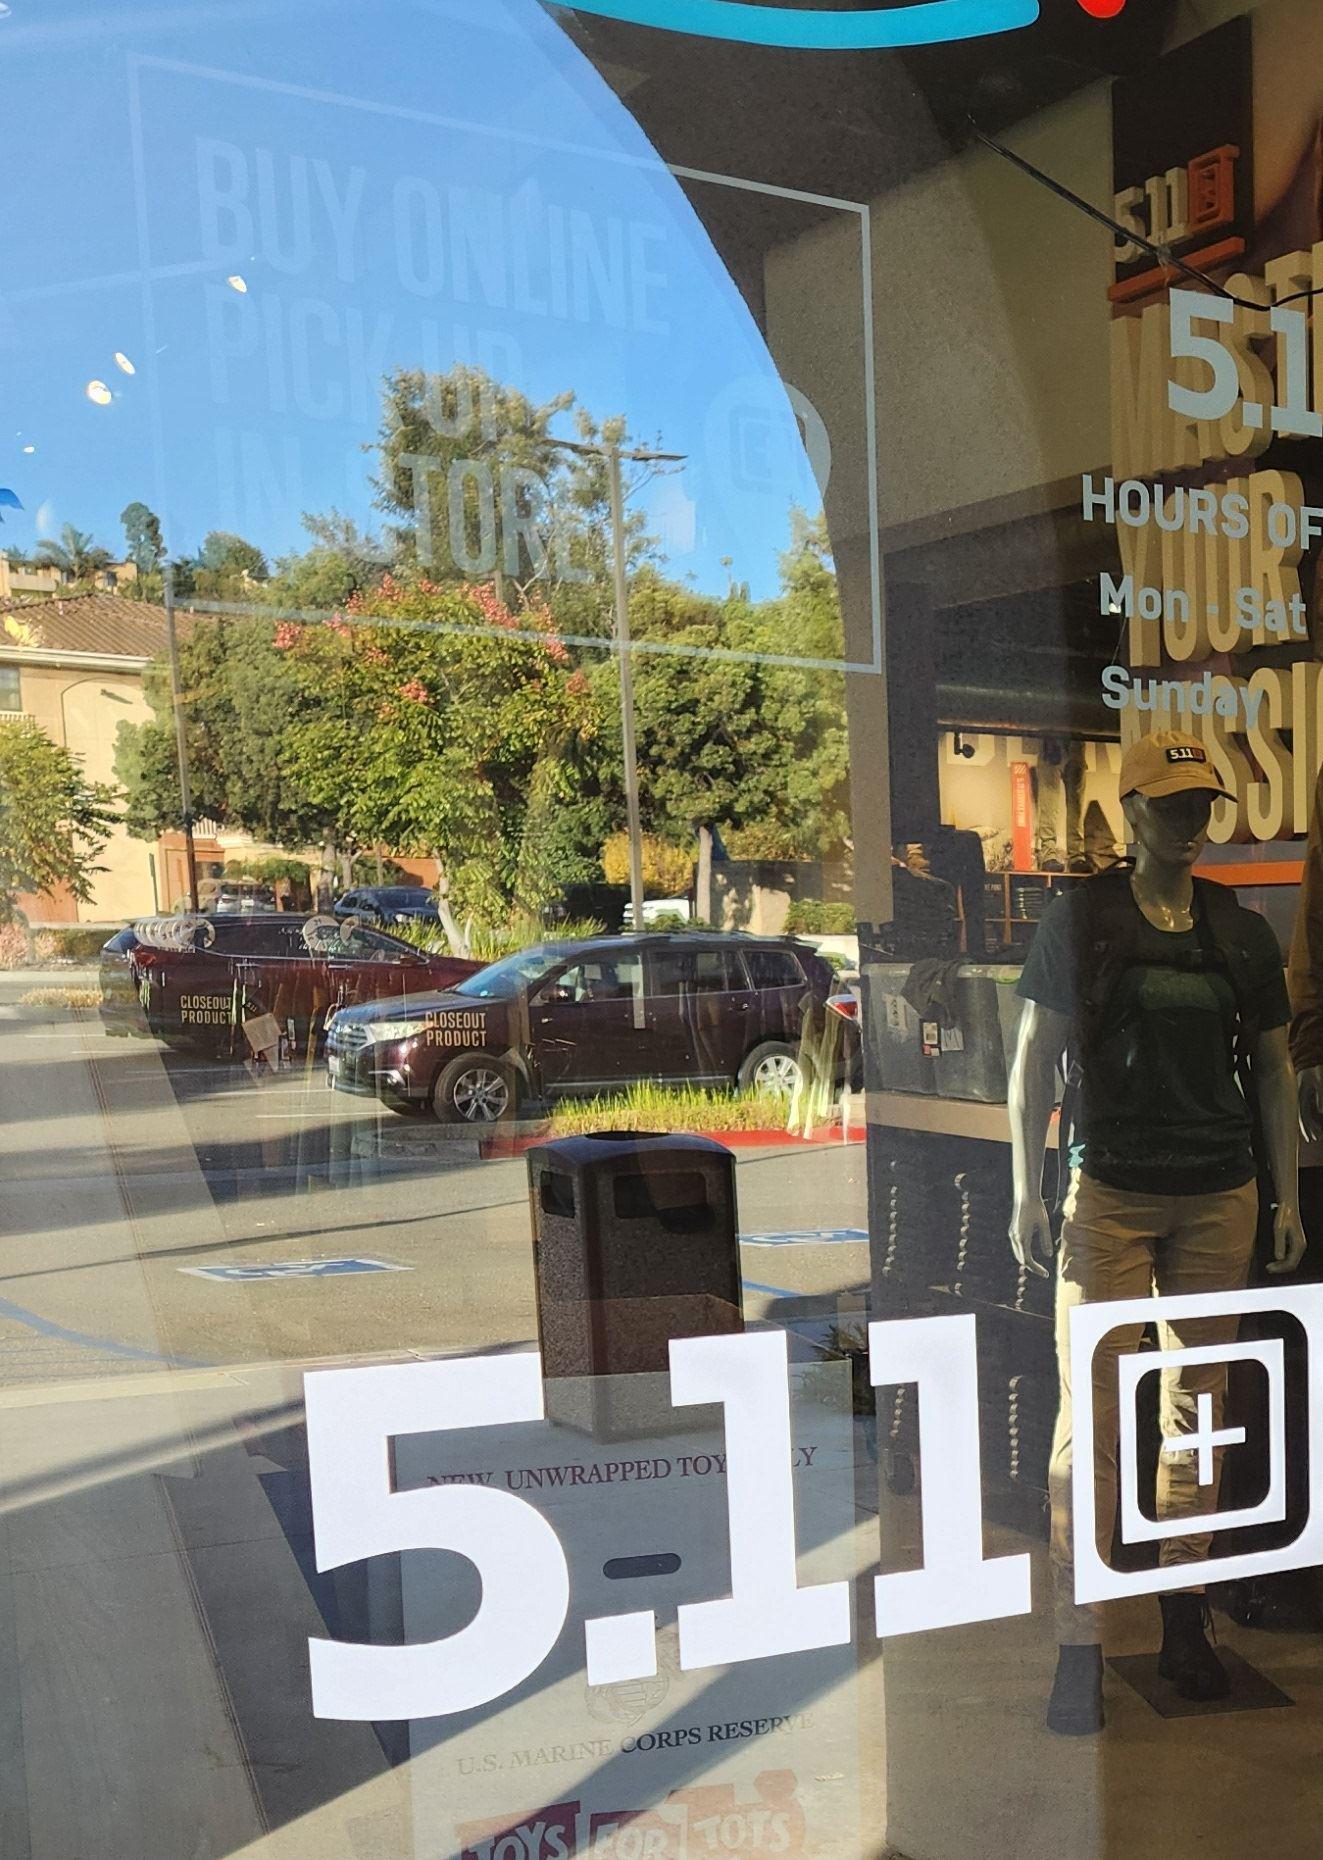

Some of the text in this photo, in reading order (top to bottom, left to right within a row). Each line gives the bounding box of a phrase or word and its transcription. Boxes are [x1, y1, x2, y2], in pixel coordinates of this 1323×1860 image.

[194, 136, 671, 336] BUY ONLINE
[204, 281, 524, 442] PICK UP
[1082, 474, 1249, 540] HOURS
[1118, 469, 1310, 668] YOUR
[1100, 572, 1191, 622] Mon
[1236, 586, 1308, 636] Sat
[1101, 665, 1264, 728] Sunday
[1169, 747, 1195, 762] 5.11
[180, 995, 232, 1010] CLOSEOUT
[181, 1010, 233, 1025] PRODUCT
[425, 1012, 486, 1030] CLOSEOUT
[426, 1029, 487, 1047] PRODUCT
[505, 1457, 672, 1491] UNWRAPPED
[304, 1314, 1032, 1721] 5.11
[457, 1711, 815, 1776] U.S. MARINE CORPS RESERVE
[694, 1808, 792, 1853] TOTS
